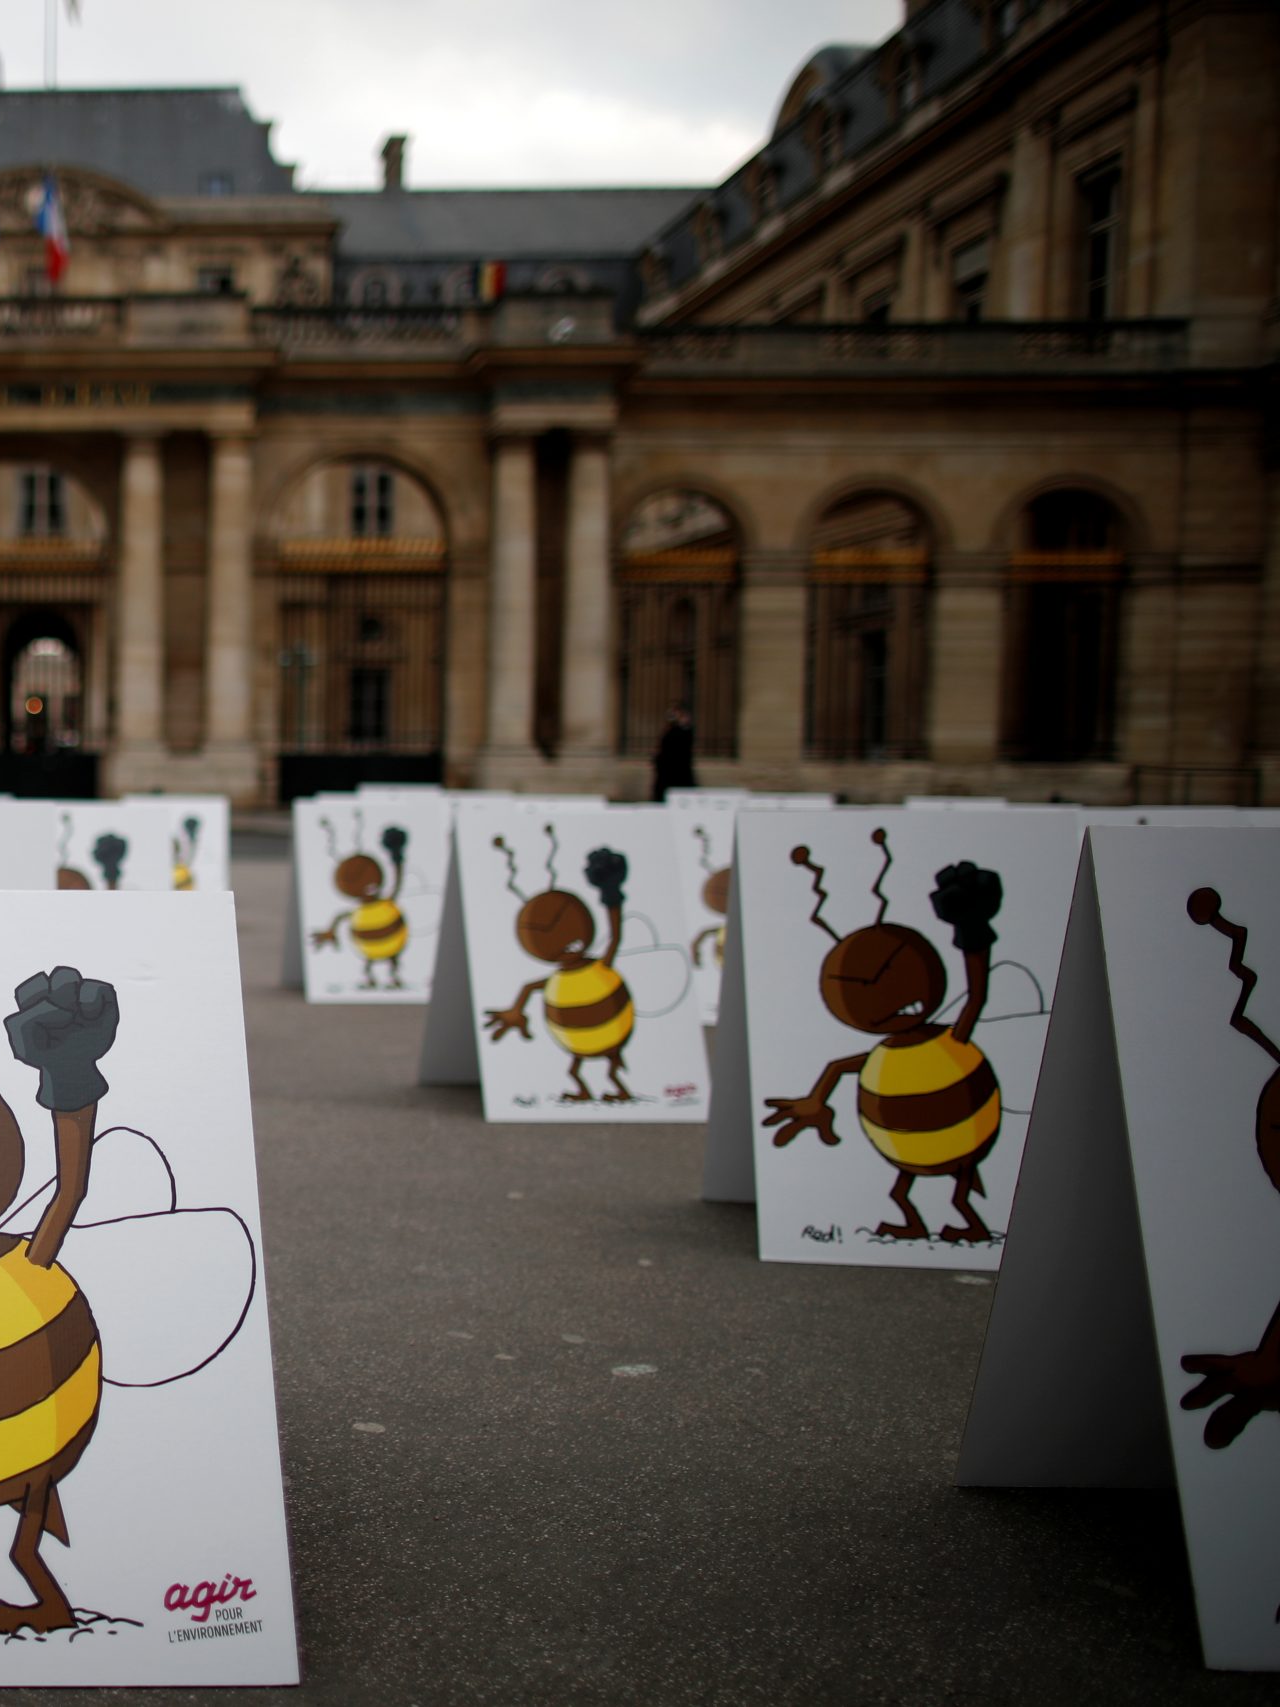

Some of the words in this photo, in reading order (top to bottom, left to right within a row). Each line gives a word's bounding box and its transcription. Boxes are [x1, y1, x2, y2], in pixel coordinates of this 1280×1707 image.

[800, 1222, 843, 1245] Red!
[163, 1572, 257, 1623] agir
[215, 1606, 243, 1622] POUR
[168, 1619, 264, 1644] L'ENVIRONNEMENT
